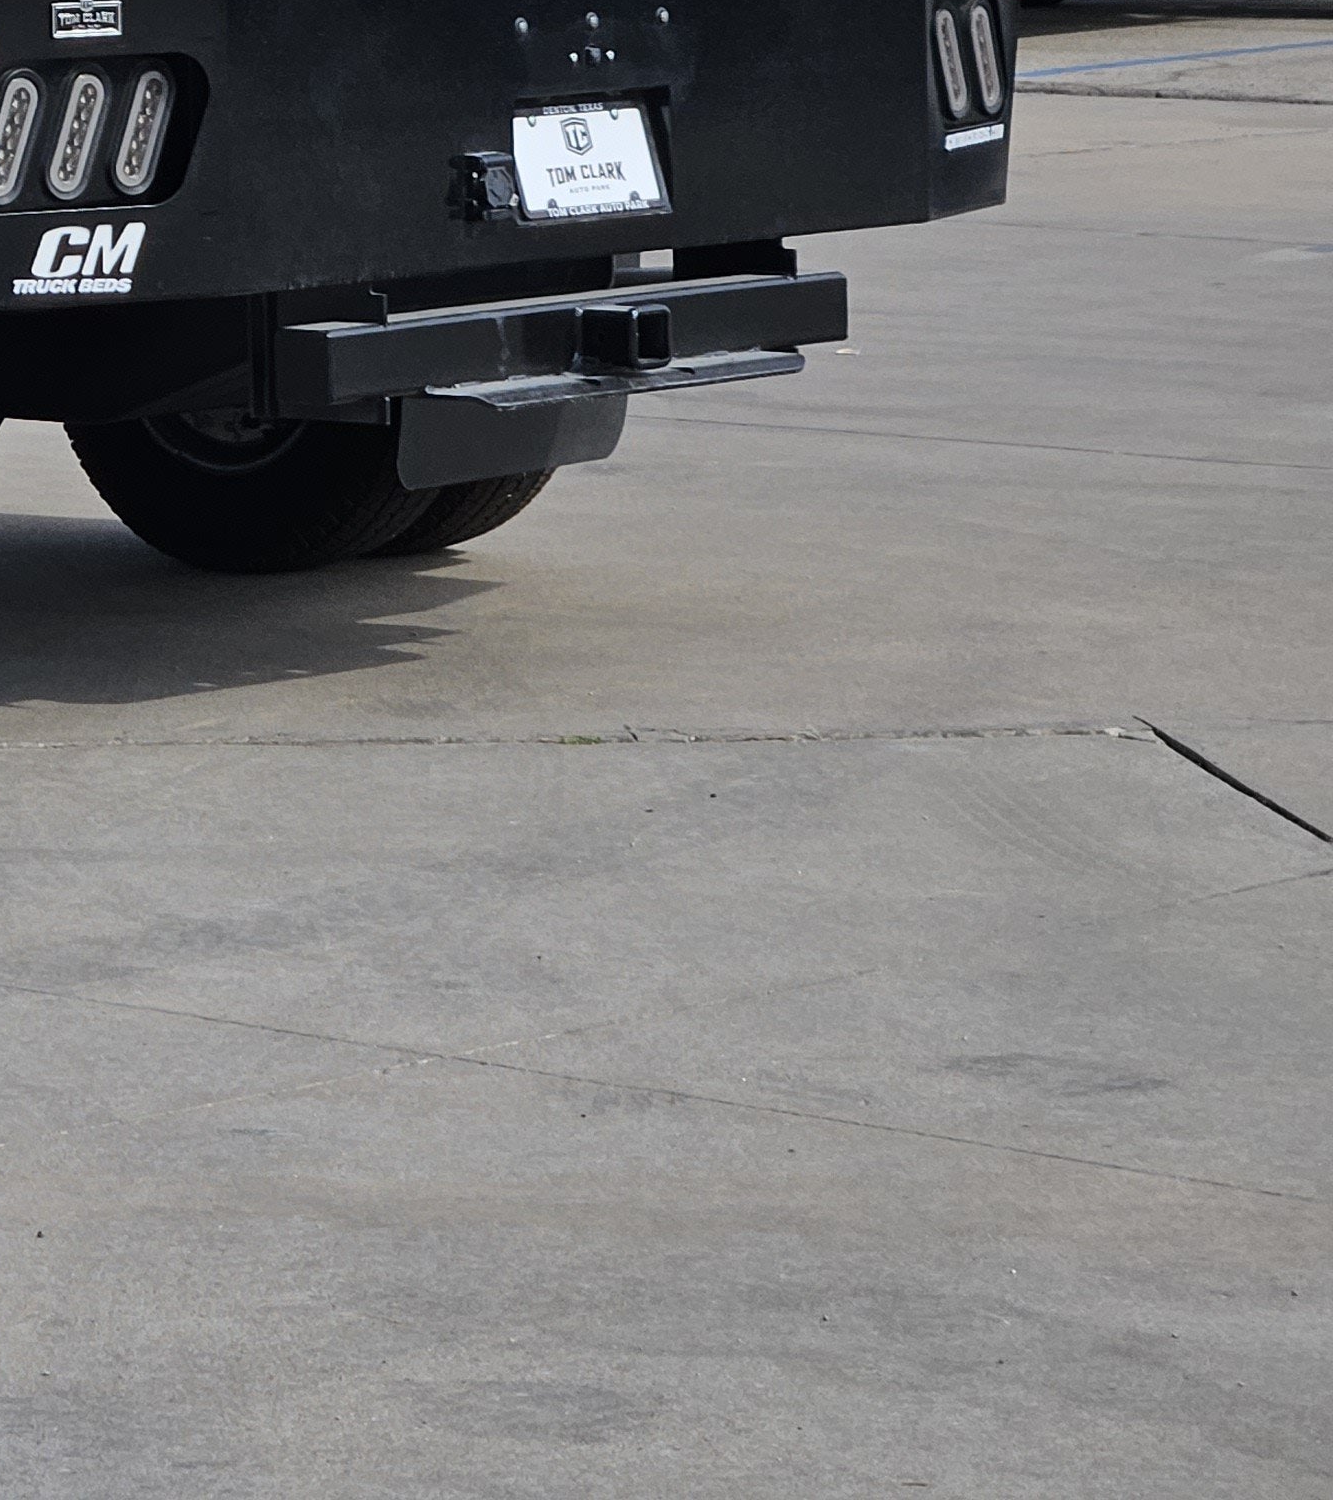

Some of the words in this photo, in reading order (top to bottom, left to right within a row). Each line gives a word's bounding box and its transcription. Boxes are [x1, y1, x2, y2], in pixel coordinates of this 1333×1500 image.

[546, 166, 577, 188] TOM
[579, 161, 627, 181] CLARK
[569, 186, 590, 194] AUTO
[547, 206, 569, 218] TOM
[568, 203, 599, 216] CLARK
[599, 201, 625, 213] AUTO
[624, 198, 651, 210] PARK
[31, 221, 146, 278] CM
[12, 278, 78, 295] TRUCK
[77, 277, 133, 294] BEDS
